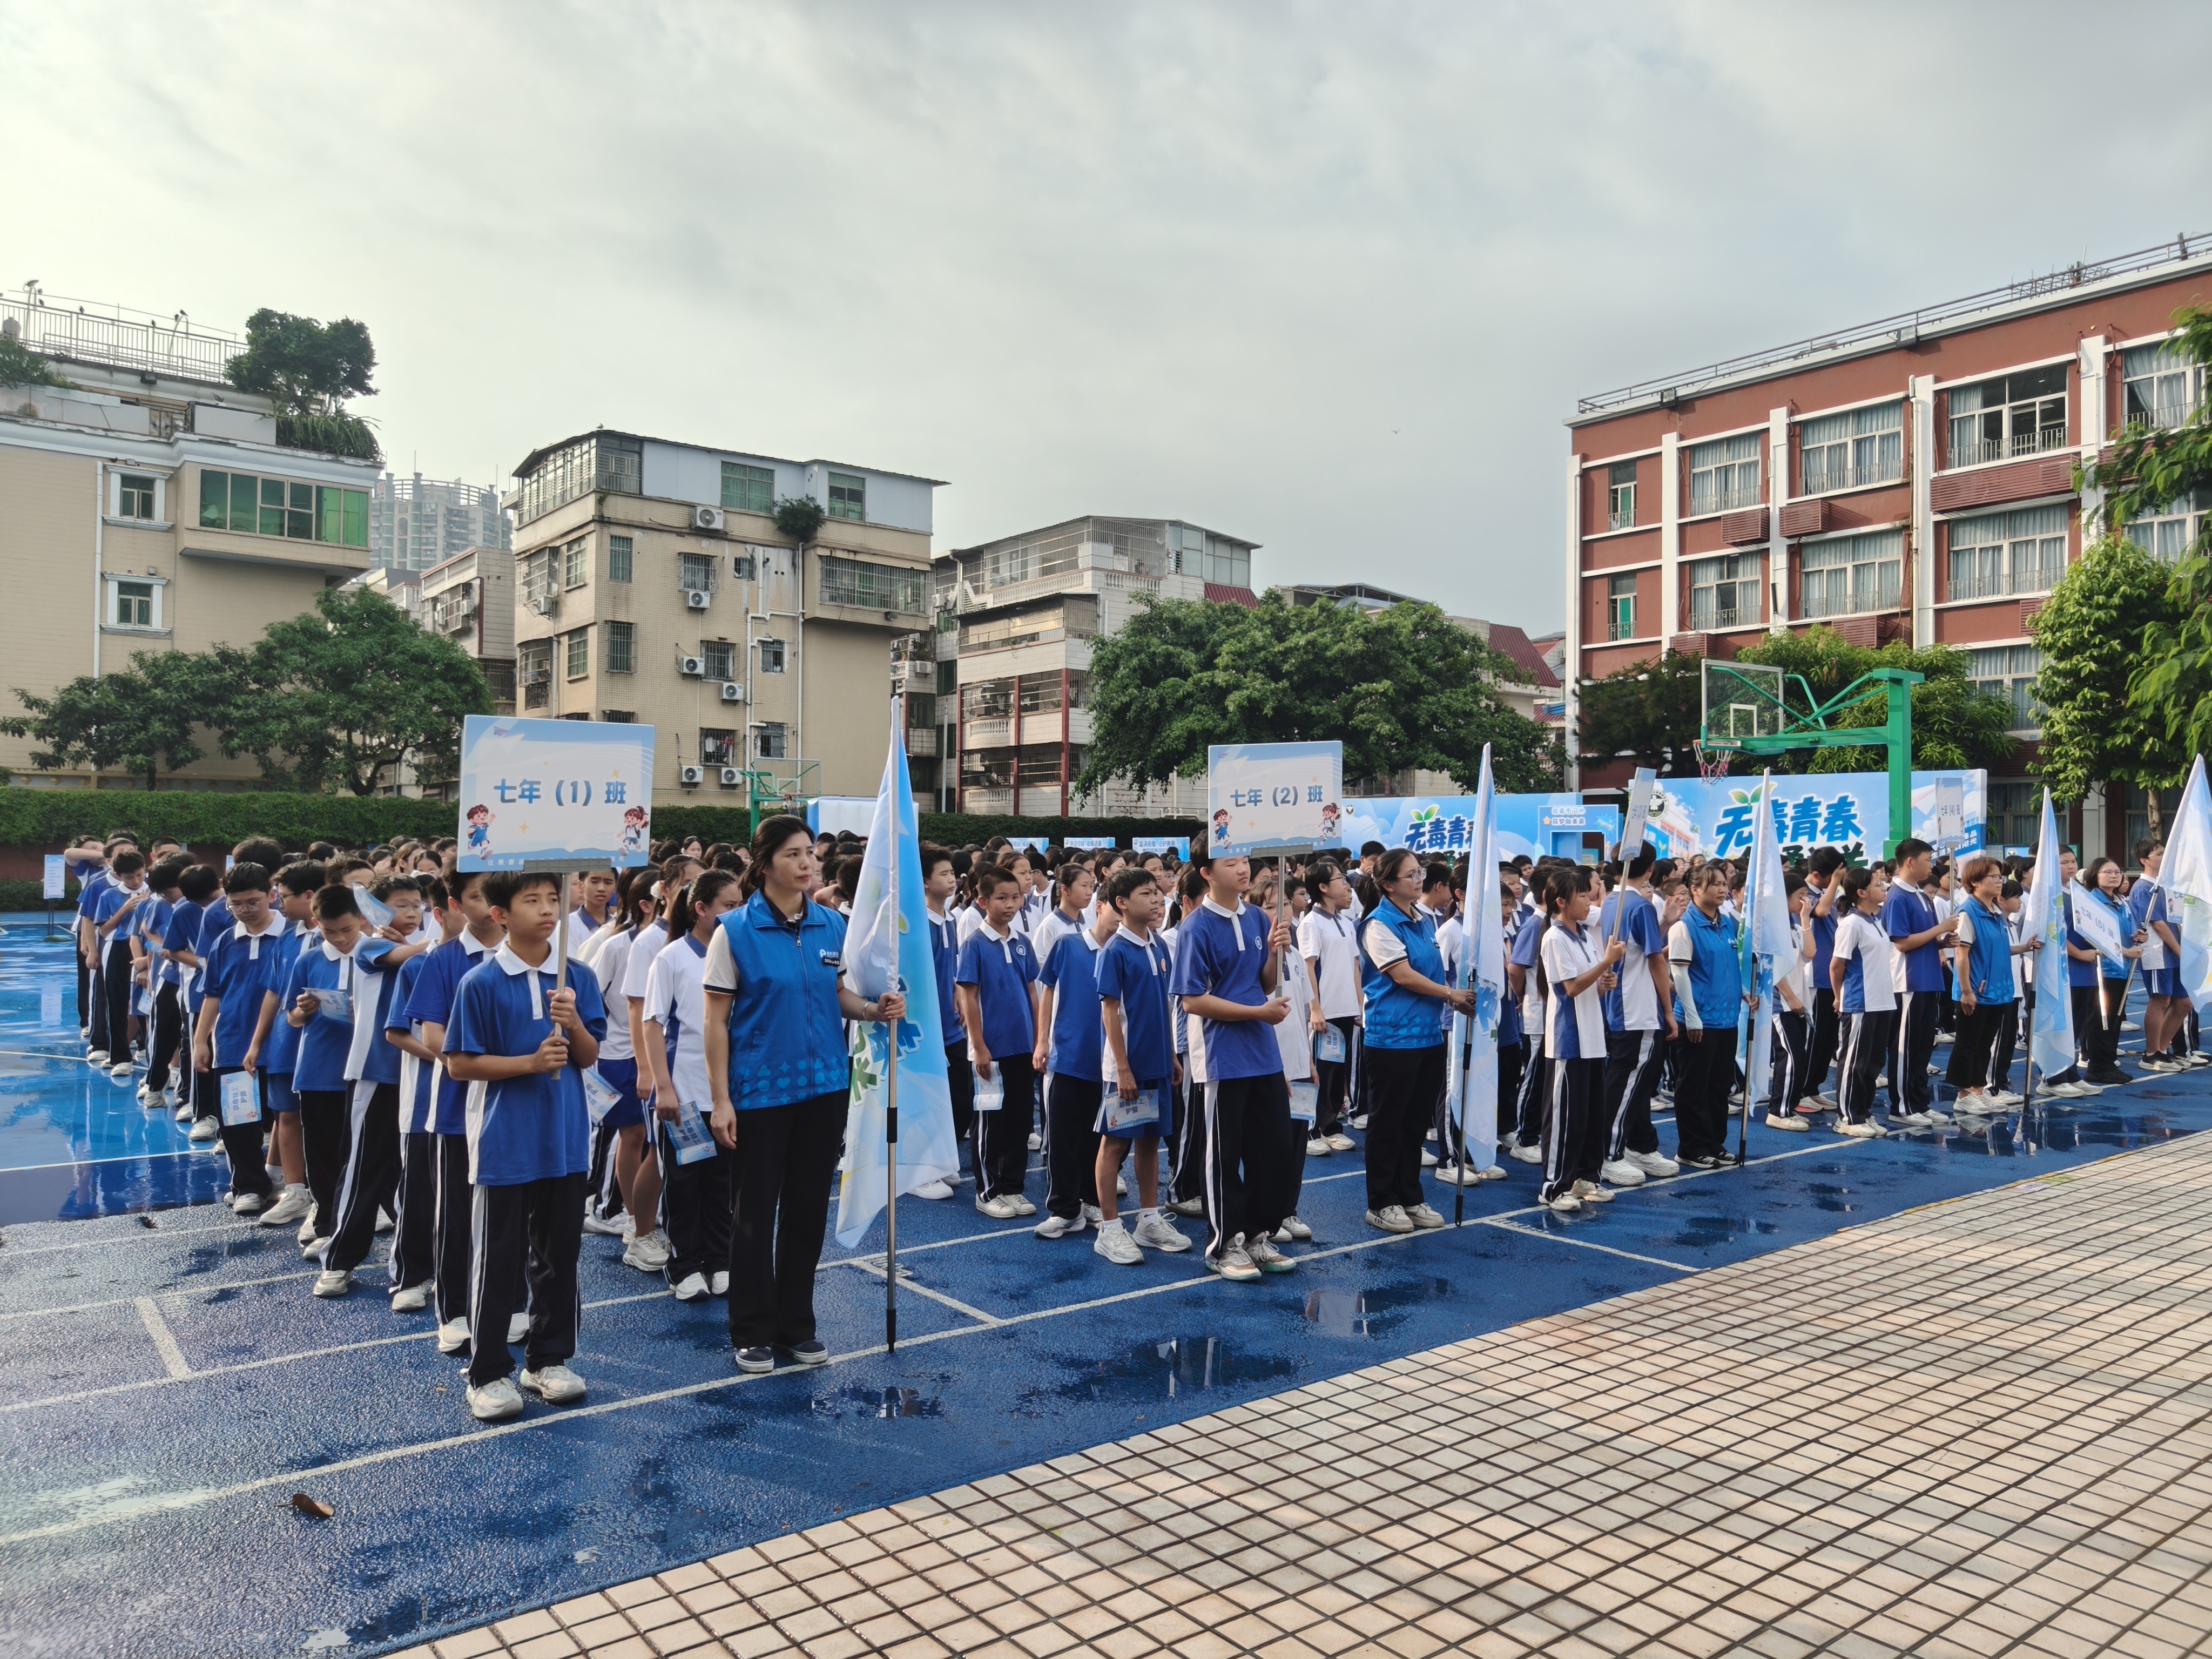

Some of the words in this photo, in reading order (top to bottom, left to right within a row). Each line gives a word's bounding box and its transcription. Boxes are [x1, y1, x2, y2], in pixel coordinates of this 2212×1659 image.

[494, 778, 626, 806] 七年（1）班
[1230, 785, 1323, 807] 七年（2）班
[1404, 815, 1474, 852] 无毒青
[2080, 905, 2114, 940] 七年（5）班
